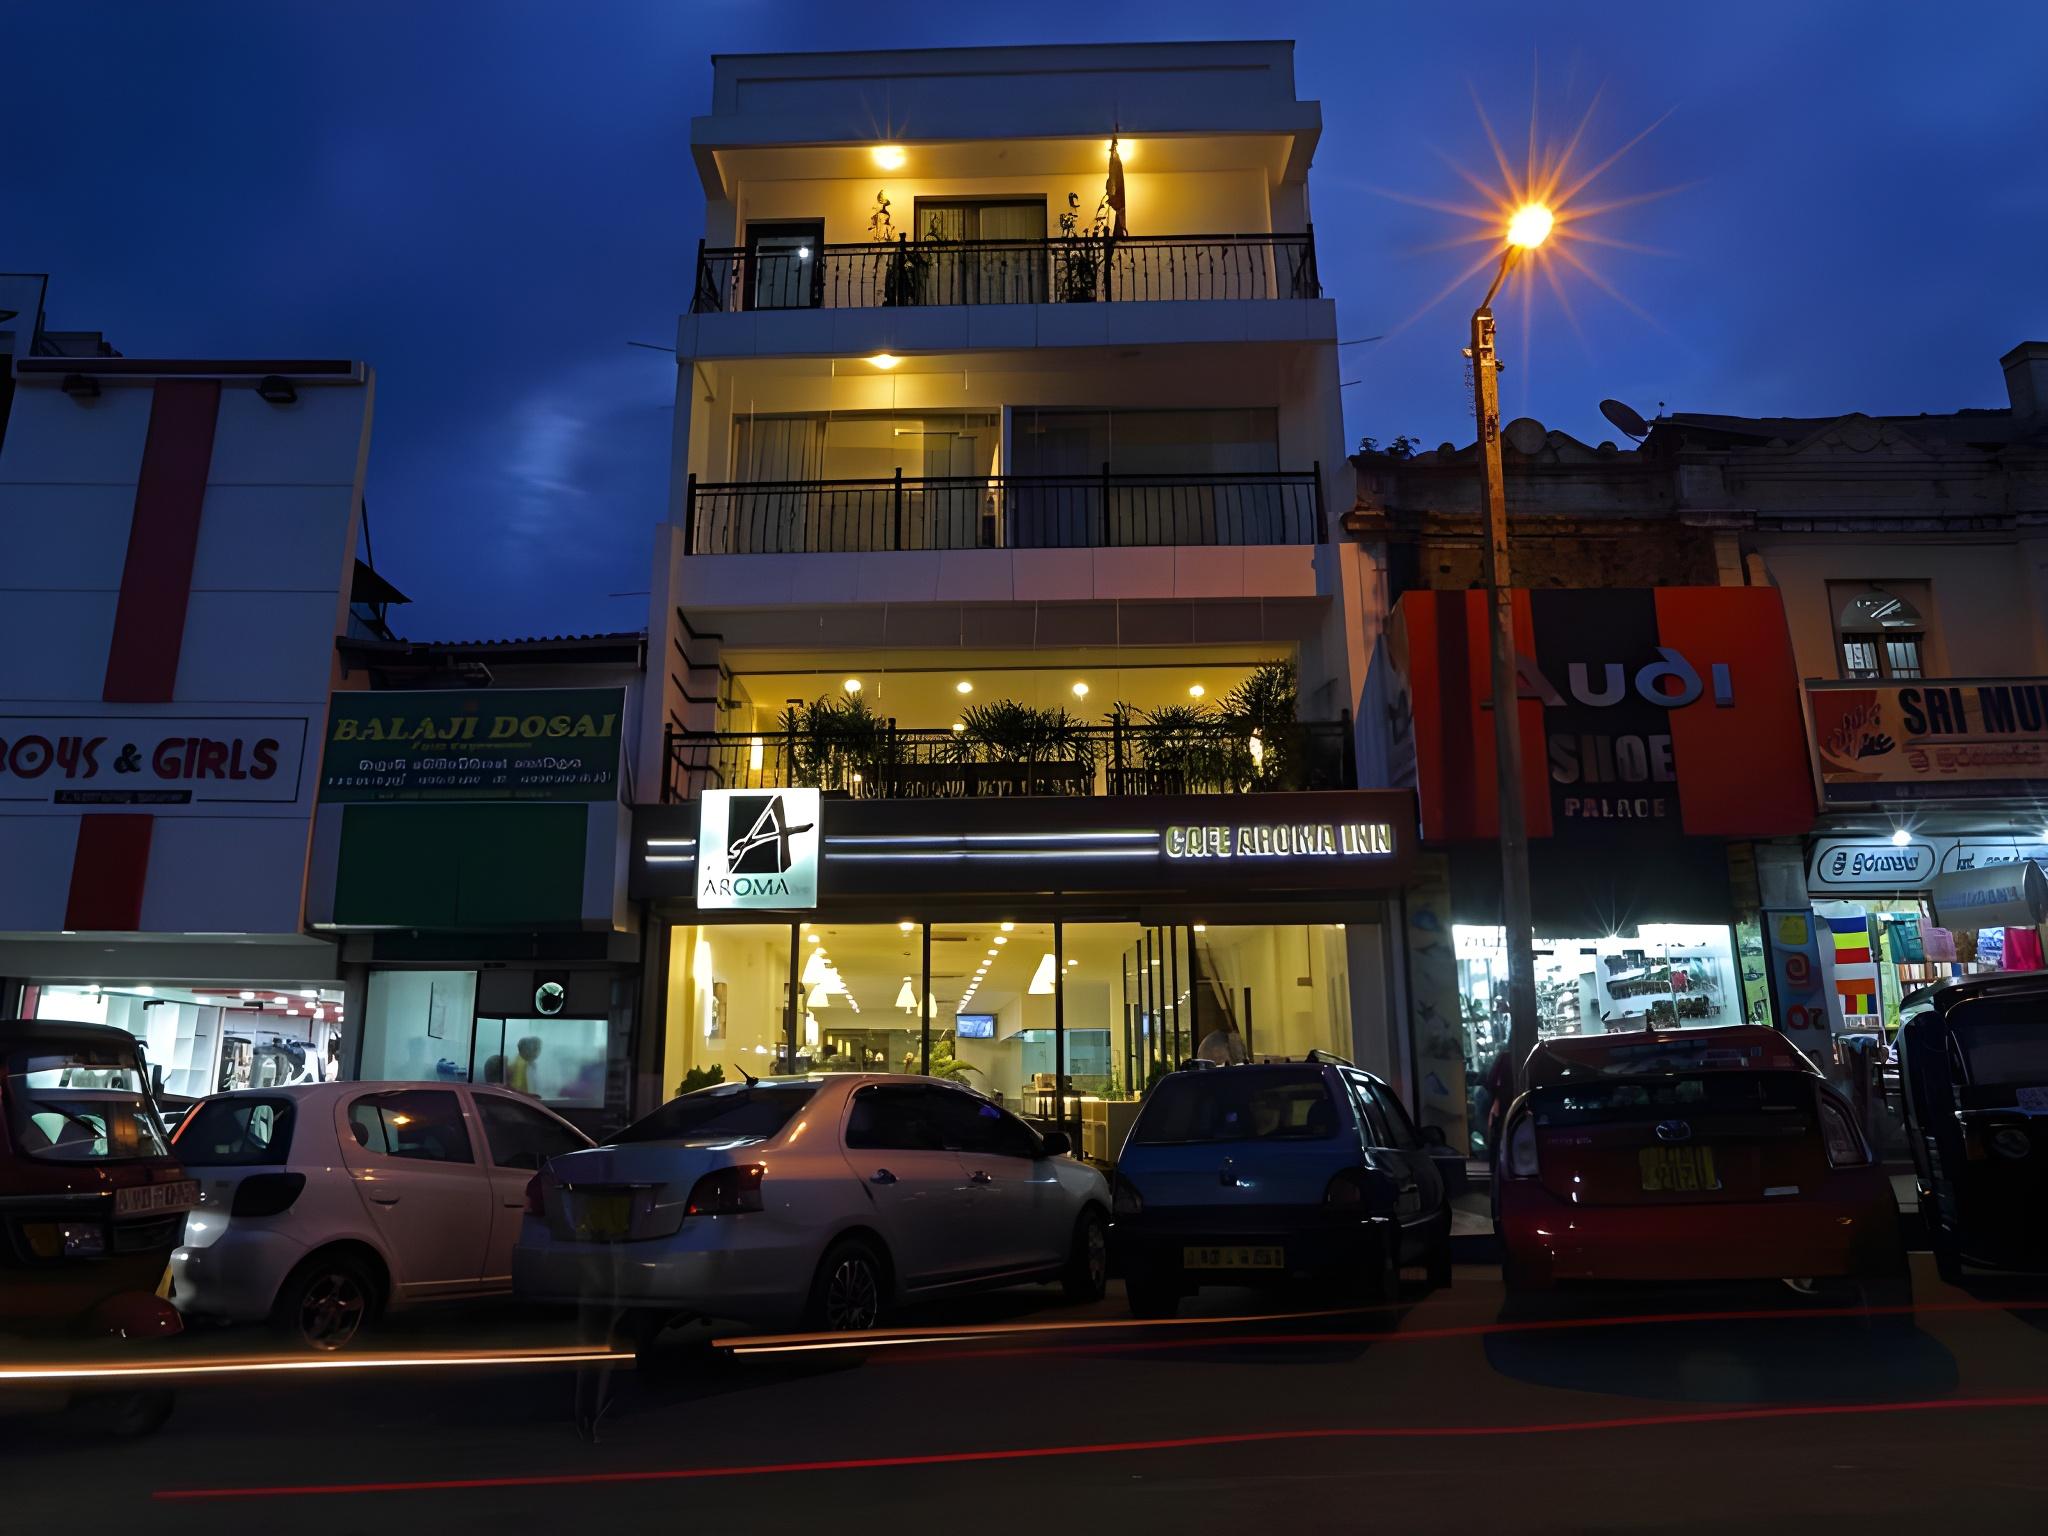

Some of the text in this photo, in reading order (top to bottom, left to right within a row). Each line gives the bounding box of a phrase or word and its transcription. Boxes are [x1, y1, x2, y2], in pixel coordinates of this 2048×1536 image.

[333, 713, 617, 742] BALAJI DOSAI
[1898, 687, 1967, 735] SRI
[0, 735, 280, 780] OYS & GIRLS
[1548, 733, 1677, 785] SHOE
[1563, 797, 1667, 819] PALACE
[1165, 823, 1392, 858] CAFE AROMA INN
[703, 878, 790, 897] AROMA
